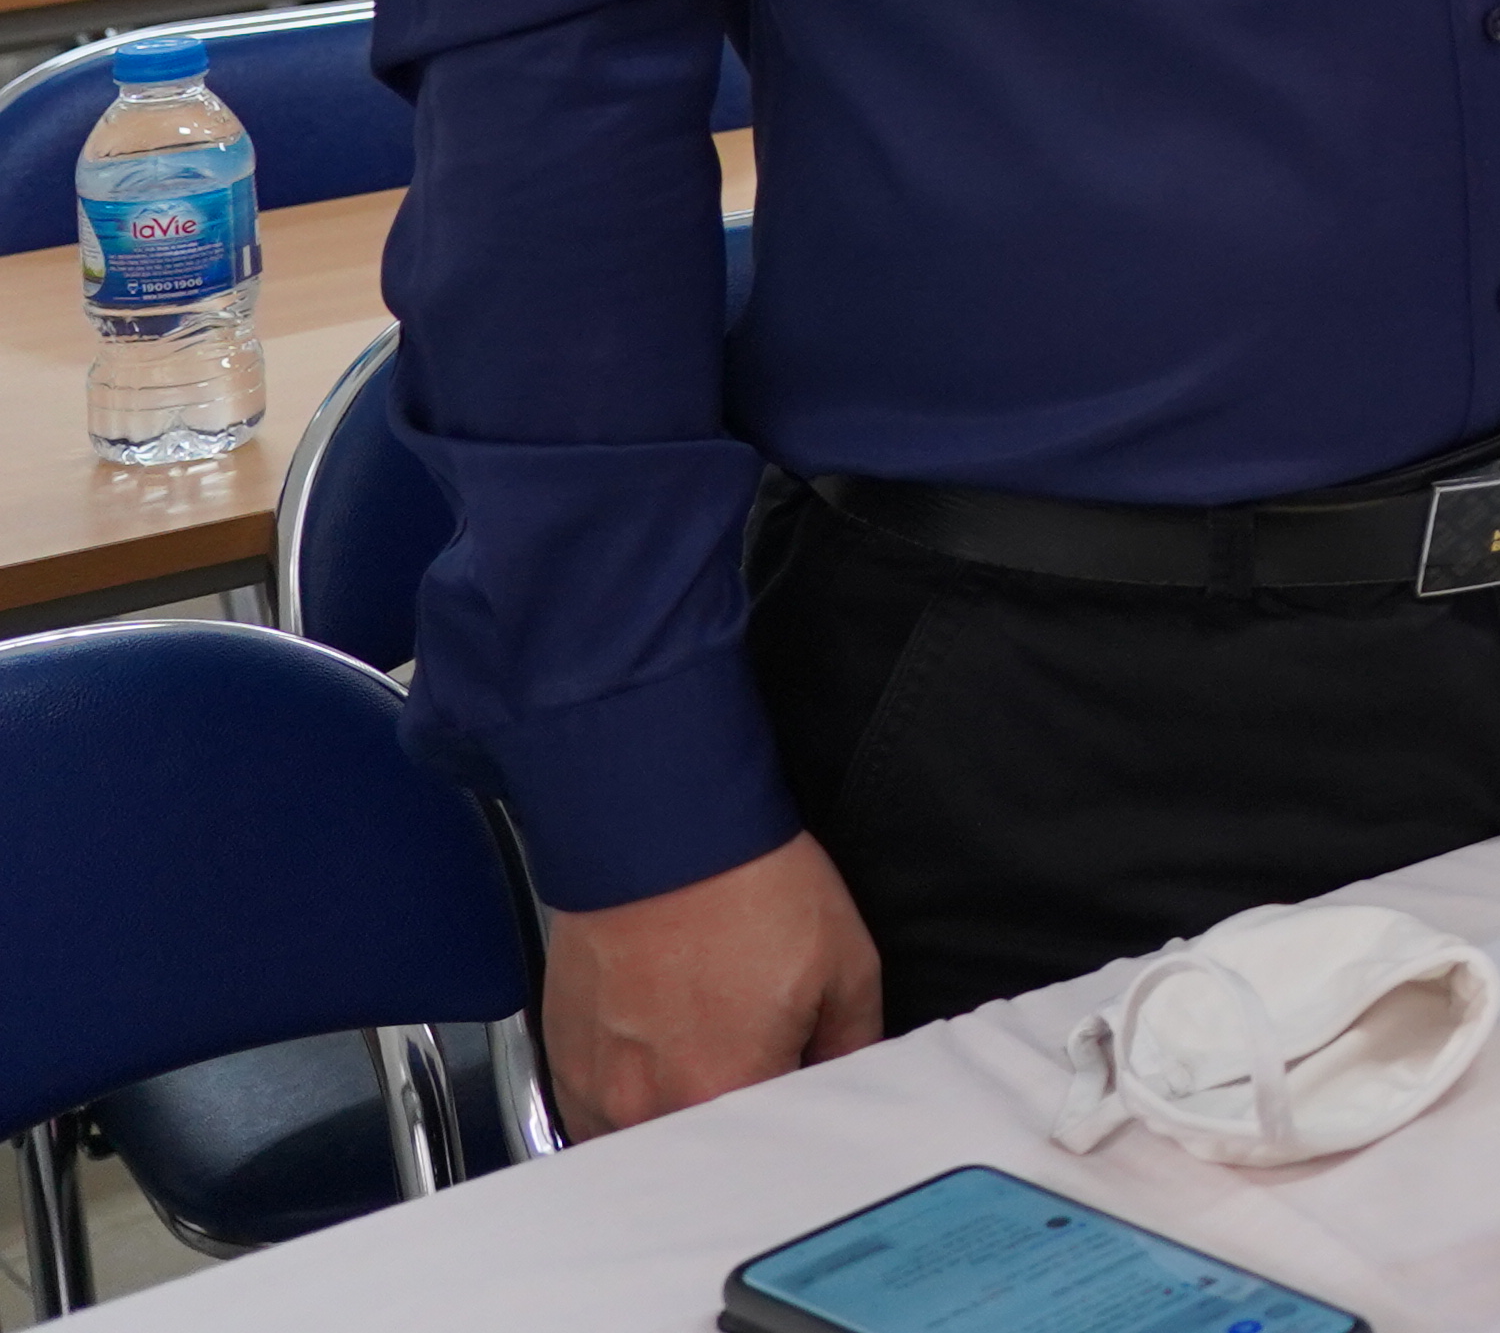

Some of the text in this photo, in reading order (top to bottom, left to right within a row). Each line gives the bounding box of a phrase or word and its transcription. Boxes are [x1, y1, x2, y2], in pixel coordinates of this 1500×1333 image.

[133, 214, 197, 240] laVie
[141, 276, 204, 294] 1900 1906
